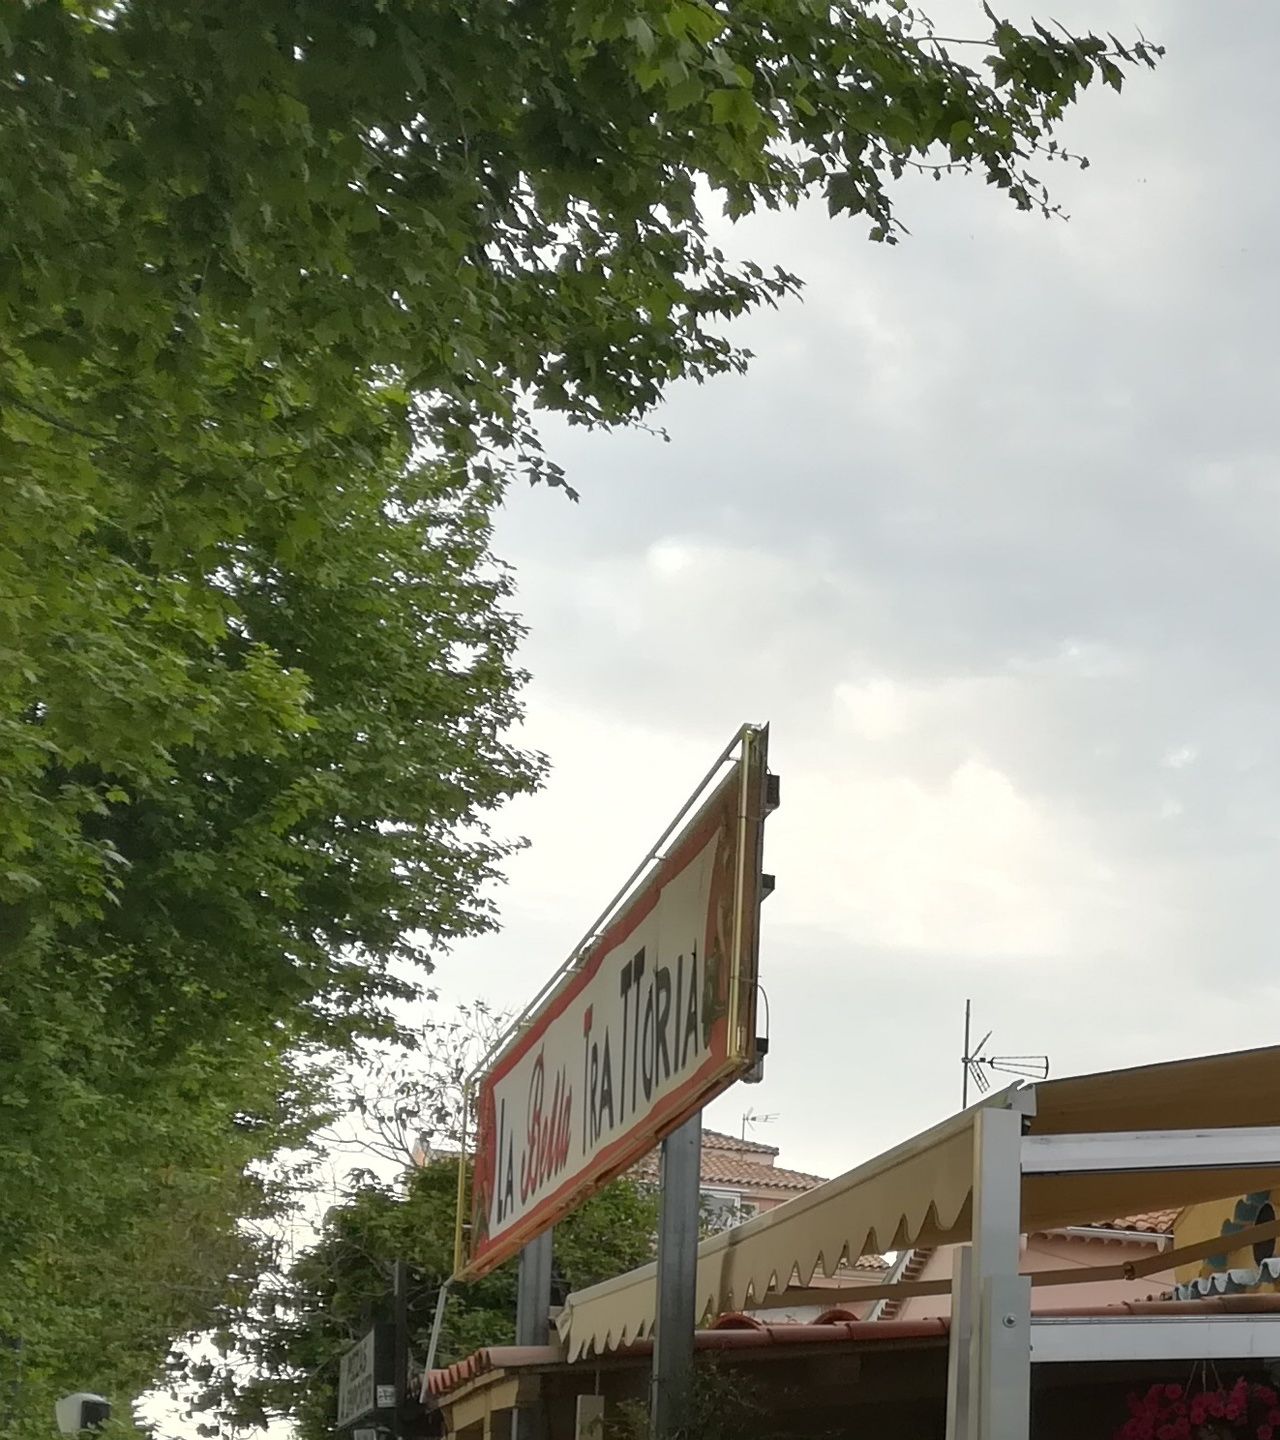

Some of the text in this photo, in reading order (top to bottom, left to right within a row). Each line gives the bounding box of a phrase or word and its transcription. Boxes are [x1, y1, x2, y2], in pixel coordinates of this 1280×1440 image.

[496, 939, 699, 1226] LA Bella TRATTORIA
